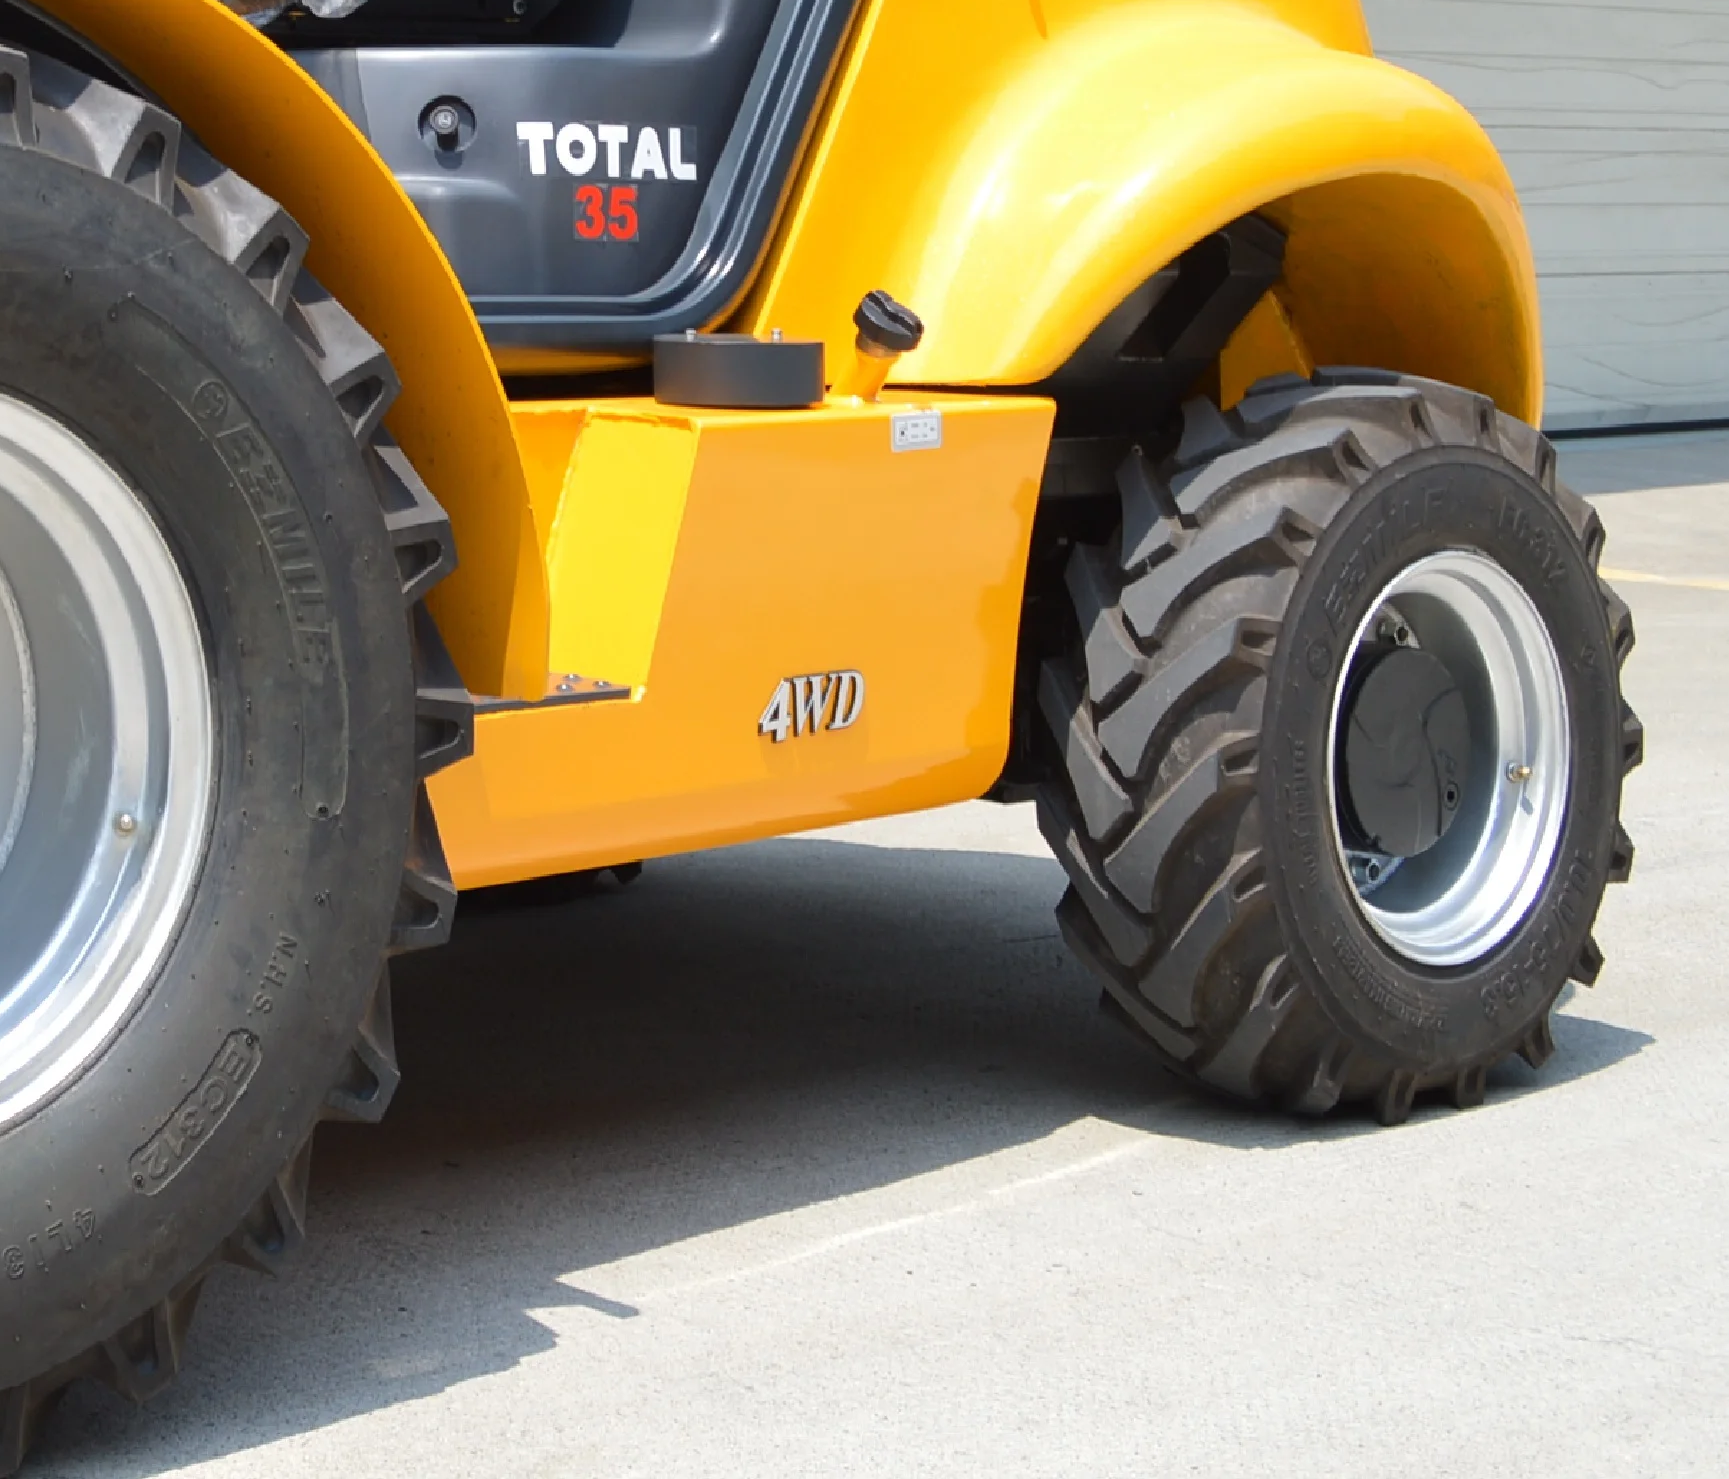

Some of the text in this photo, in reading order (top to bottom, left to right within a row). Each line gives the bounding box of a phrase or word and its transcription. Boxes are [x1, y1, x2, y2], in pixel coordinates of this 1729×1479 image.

[516, 122, 697, 180] TOTAL
[575, 184, 638, 240] 35
[757, 669, 864, 743] 4WD
